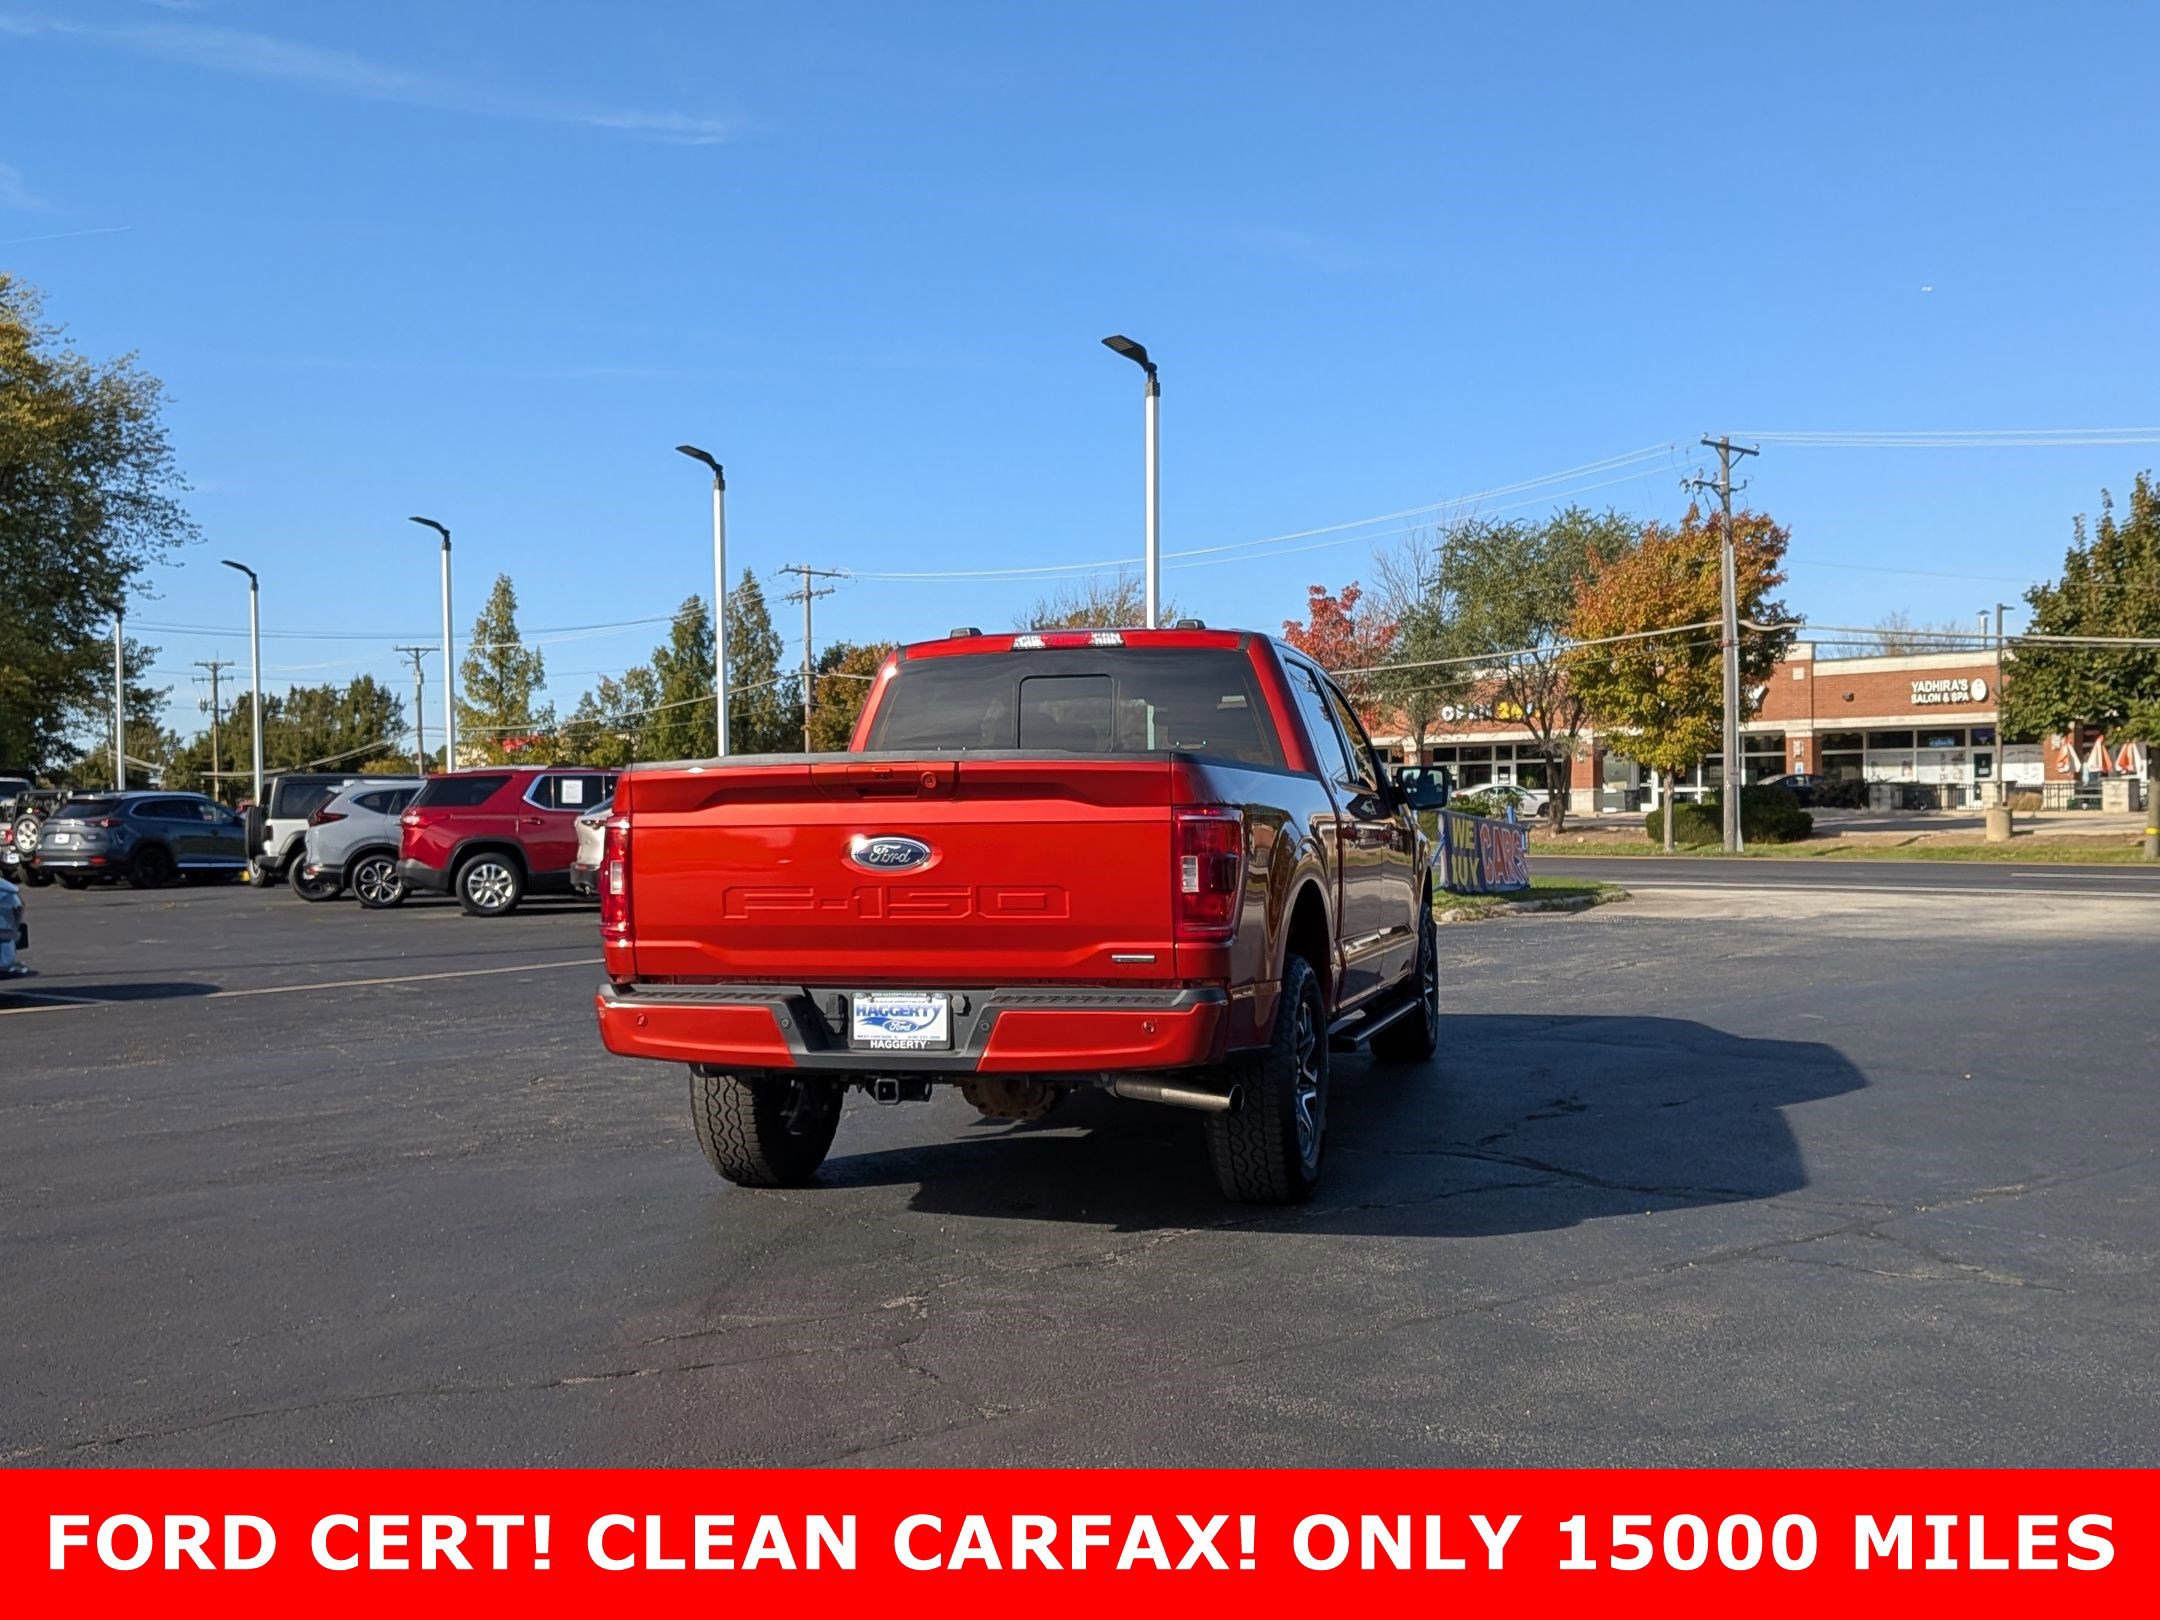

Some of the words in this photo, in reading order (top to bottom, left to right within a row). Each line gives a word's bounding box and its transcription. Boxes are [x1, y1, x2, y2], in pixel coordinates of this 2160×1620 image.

[1911, 679, 1969, 692] YADHIRA'S
[1911, 692, 1941, 704] SALON
[1942, 692, 1950, 703] &
[1951, 691, 1969, 703] SPA
[1452, 817, 1476, 850] WE
[869, 842, 911, 864] Ford
[722, 885, 1070, 919] F-150
[856, 1004, 943, 1018] HAGGERTY
[888, 1020, 912, 1032] Ford
[870, 1039, 927, 1049] HAGGERTY
